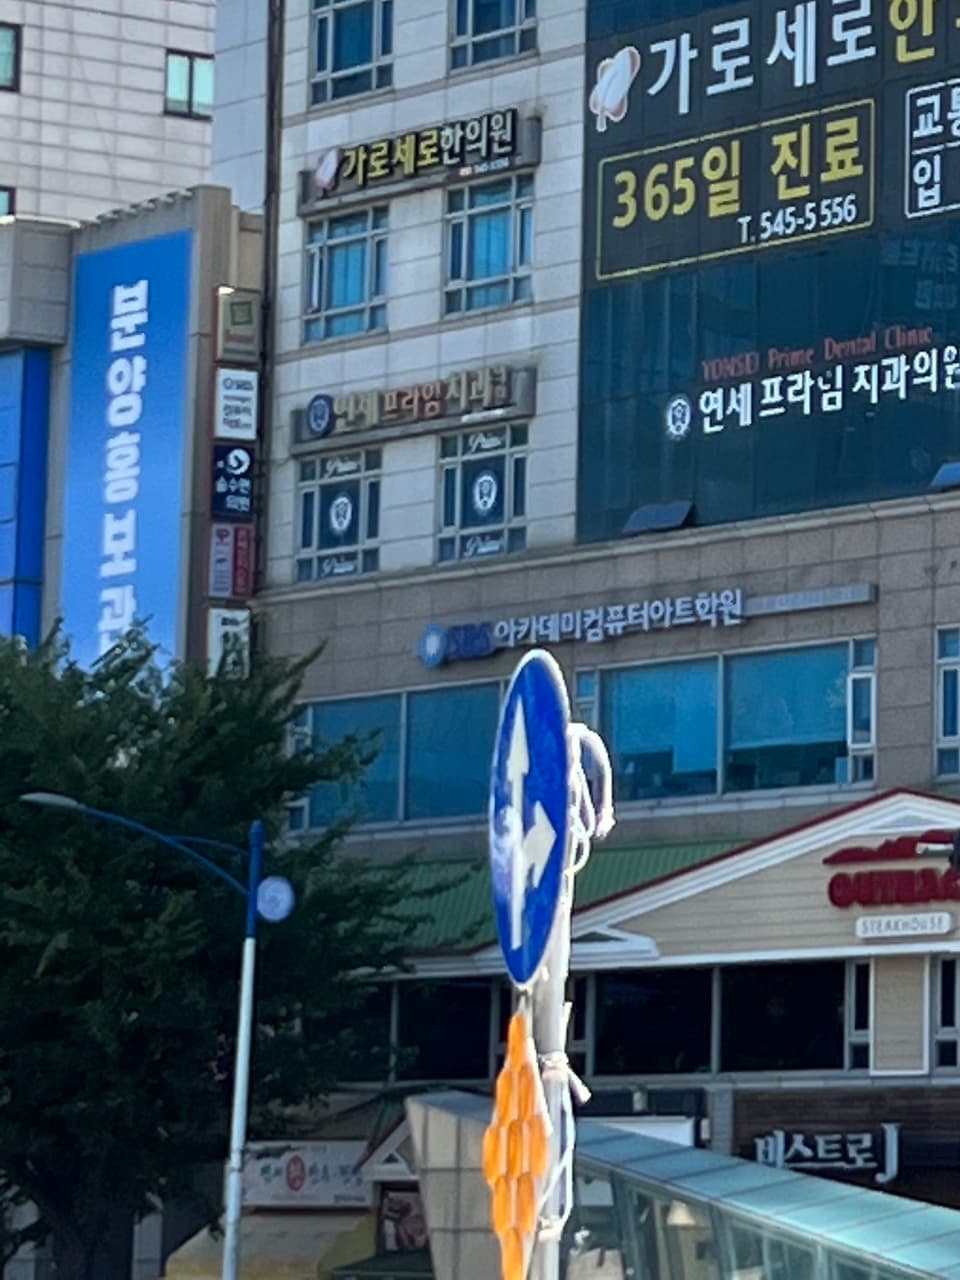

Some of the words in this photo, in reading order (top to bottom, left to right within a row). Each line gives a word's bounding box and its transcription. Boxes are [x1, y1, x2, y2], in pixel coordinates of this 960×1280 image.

[343, 110, 513, 186] 가로세로한의원
[613, 139, 741, 229] 365일
[771, 117, 863, 200] 진료
[760, 193, 857, 240] 545-5556
[493, 588, 743, 643] 아카데미컴퓨터아트학원
[861, 916, 946, 935] STEAKHOUSE
